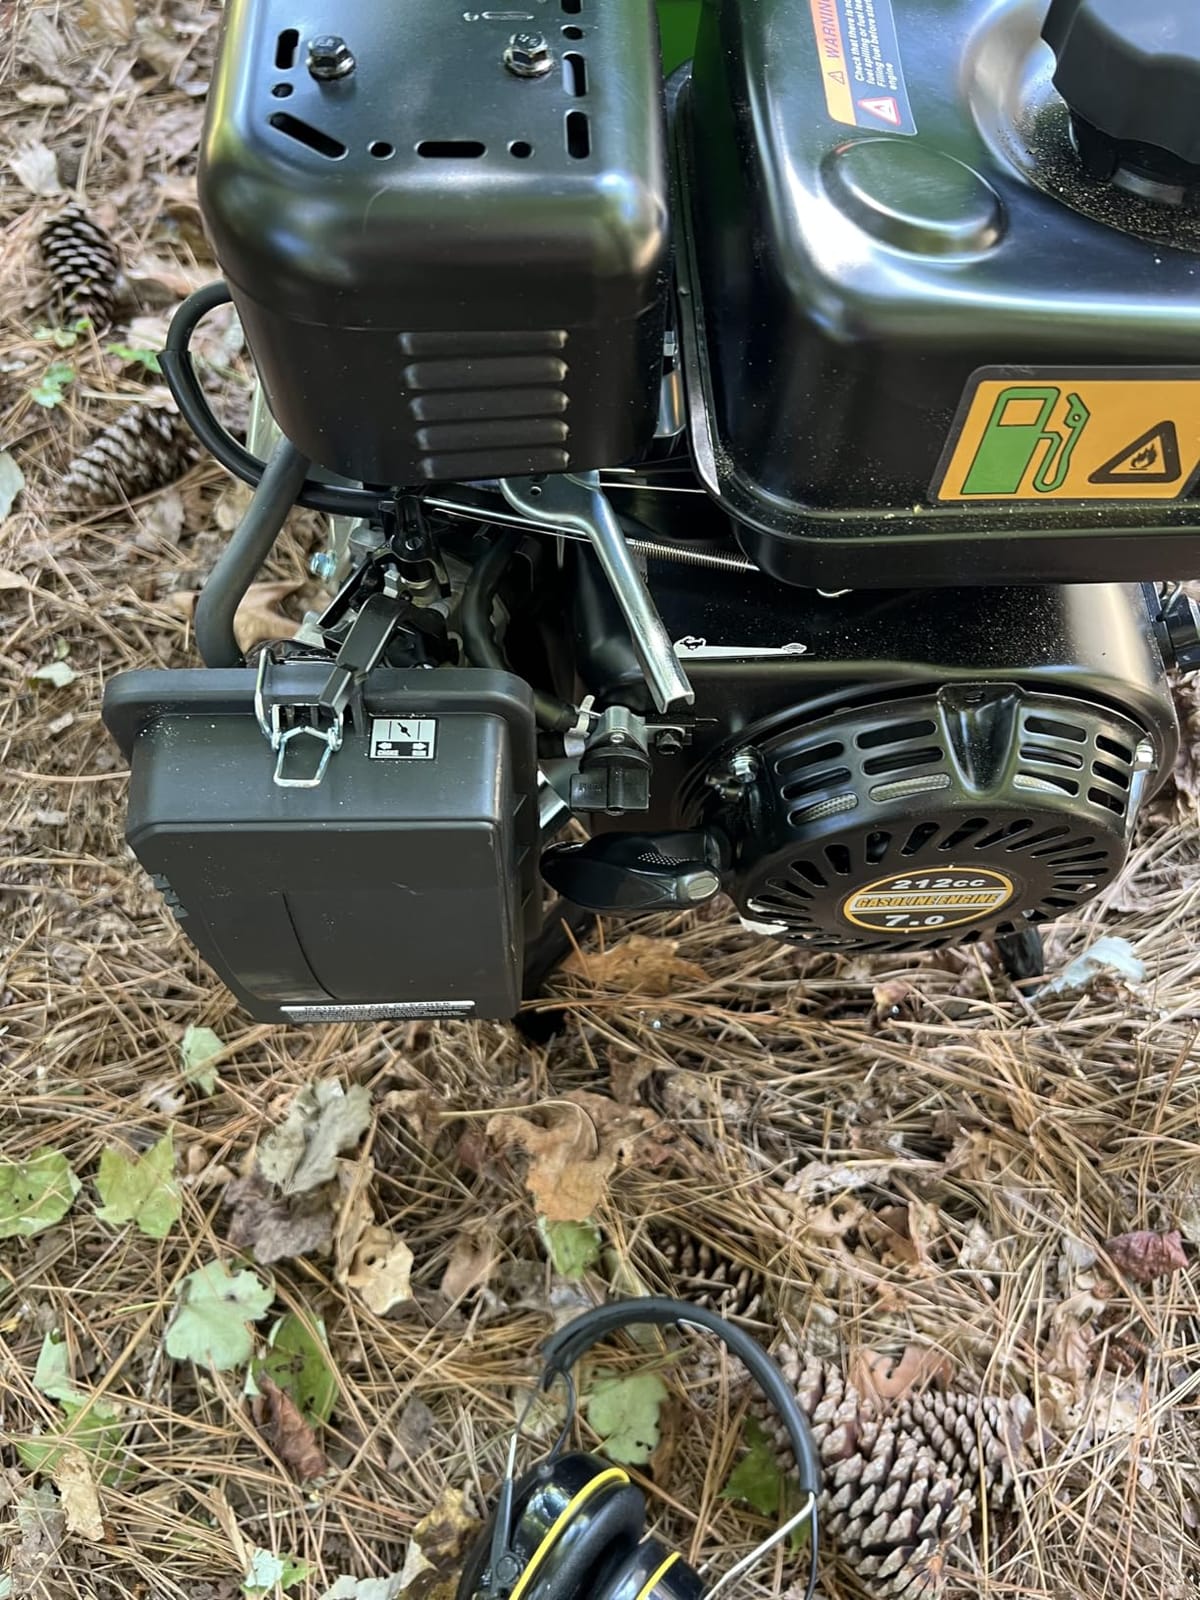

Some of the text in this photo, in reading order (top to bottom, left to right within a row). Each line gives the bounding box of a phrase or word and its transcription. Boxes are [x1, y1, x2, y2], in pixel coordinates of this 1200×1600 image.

[847, 18, 857, 39] there
[856, 13, 866, 27] fuel
[818, 0, 839, 58] WARNIN
[859, 28, 868, 38] or
[868, 18, 879, 45] before
[850, 39, 860, 56] that
[871, 45, 882, 61] fuel
[852, 56, 865, 81] Check
[864, 67, 875, 85] fuel
[875, 61, 887, 87] Filling
[885, 62, 898, 90] engine
[891, 878, 986, 890] 212cc
[856, 893, 999, 908] GASOLINE ENGINE
[885, 914, 945, 927] 7.0
